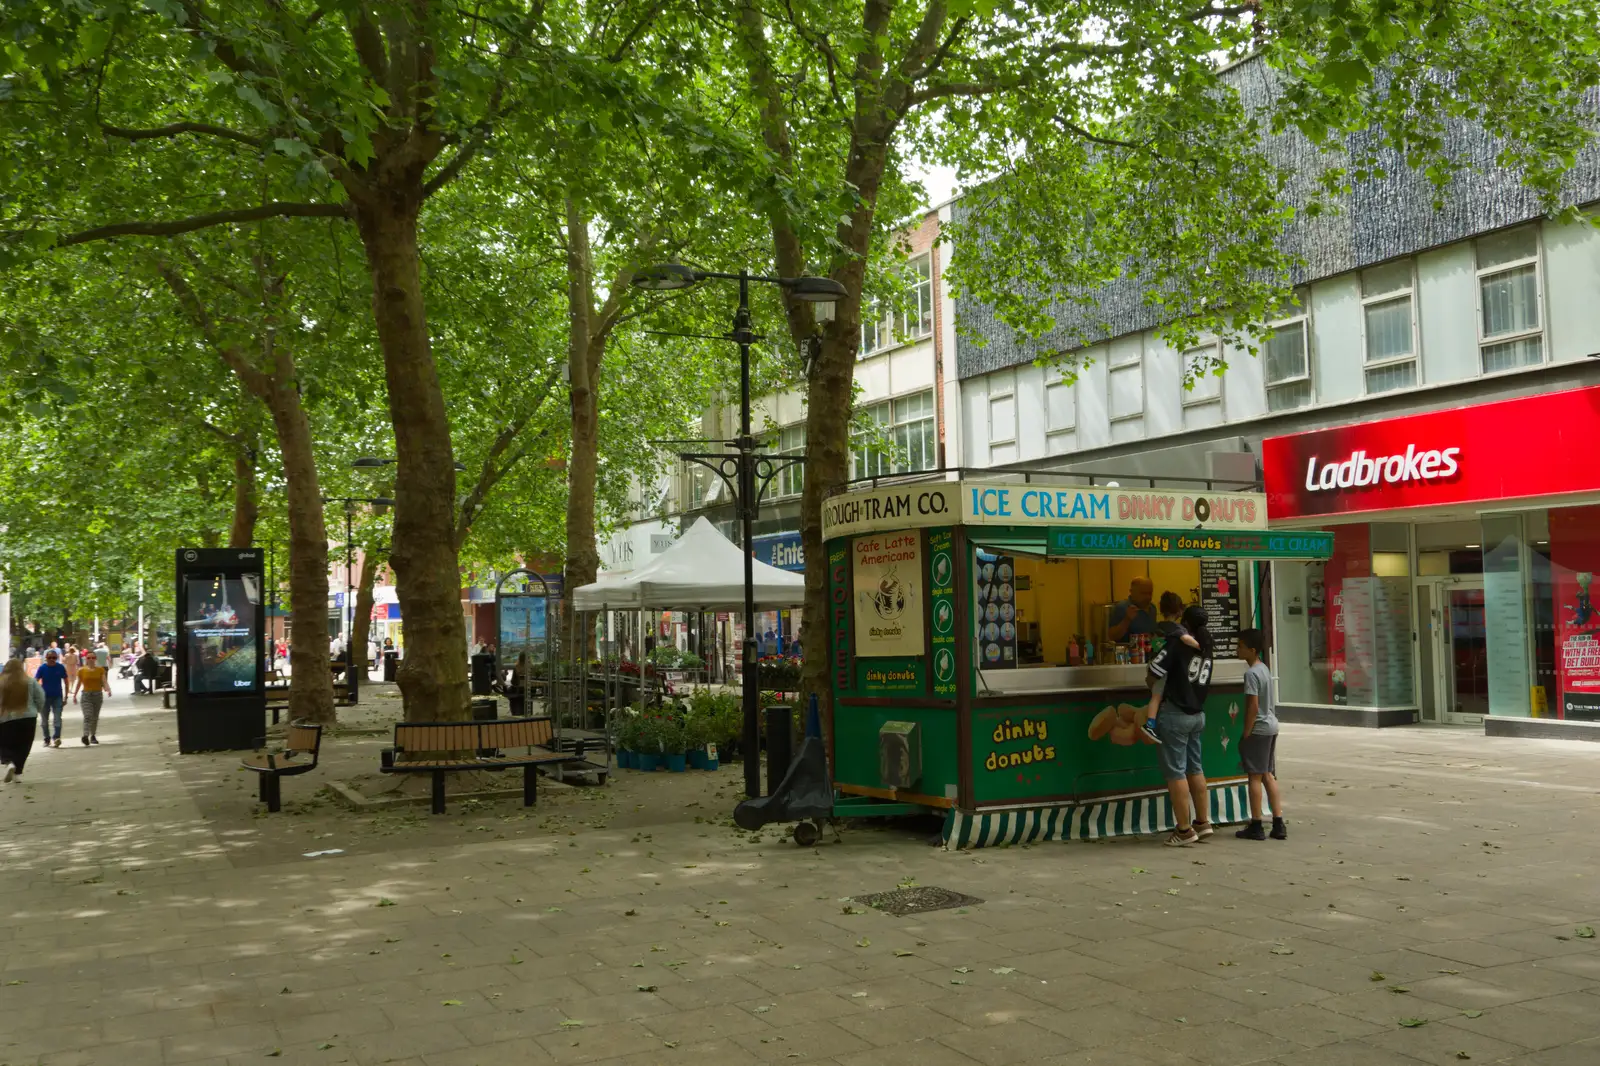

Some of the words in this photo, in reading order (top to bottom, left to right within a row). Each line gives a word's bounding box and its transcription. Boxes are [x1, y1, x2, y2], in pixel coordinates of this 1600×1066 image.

[1306, 444, 1460, 491] Ladbrokes
[864, 494, 910, 520] TRAM
[918, 492, 948, 514] CO.
[972, 488, 1011, 516] ICE
[1022, 491, 1110, 519] CREAM
[1117, 495, 1176, 520] DINKY
[1182, 497, 1256, 523] DONUTS
[856, 540, 880, 553] Cafe
[885, 536, 915, 550] Latte
[1058, 533, 1076, 547] ICE
[1082, 534, 1127, 548] CREAM
[1133, 534, 1169, 552] dinky
[1178, 536, 1222, 550] donuts
[1269, 537, 1285, 550] ICE
[1289, 538, 1328, 551] CREAM
[860, 551, 915, 566] Americano
[1565, 649, 1580, 657] WITH
[1582, 648, 1586, 656] A
[1567, 658, 1579, 667] BET
[867, 669, 886, 683] dinky
[888, 670, 915, 680] donuts
[1188, 656, 1211, 685] 96
[992, 718, 1048, 742] dinky
[986, 744, 1056, 772] donuts
